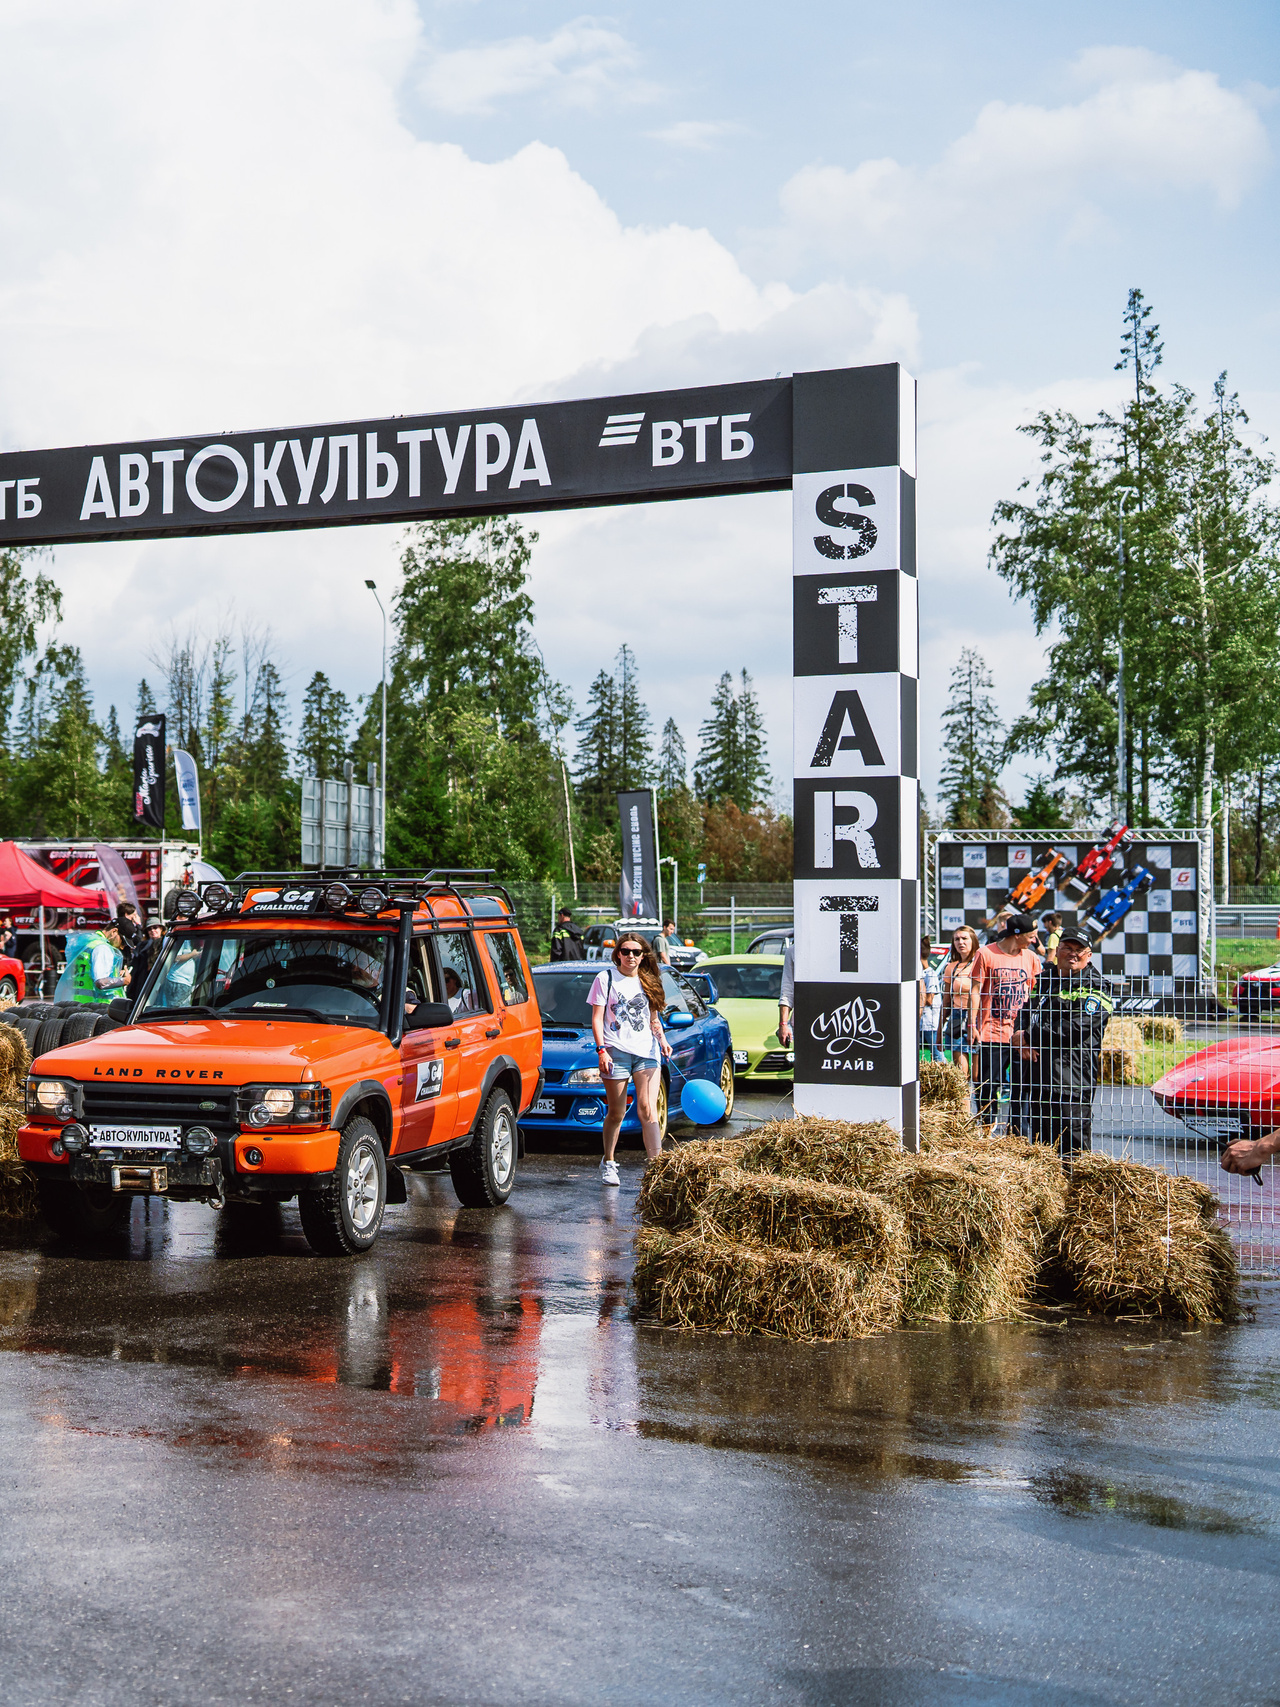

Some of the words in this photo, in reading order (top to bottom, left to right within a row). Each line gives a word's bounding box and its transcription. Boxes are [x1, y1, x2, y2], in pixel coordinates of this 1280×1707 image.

[652, 412, 755, 467] ВТБ
[79, 418, 552, 521] АВТОКУЛЬТУРА
[810, 482, 886, 974] START
[283, 890, 315, 902] G4
[431, 1063, 442, 1081] G4
[821, 1057, 874, 1071] ДРАЙВ
[94, 1067, 143, 1077] LAND
[156, 1069, 224, 1079] ROVER
[100, 1130, 171, 1143] АВТОКУЛЬТУРА
